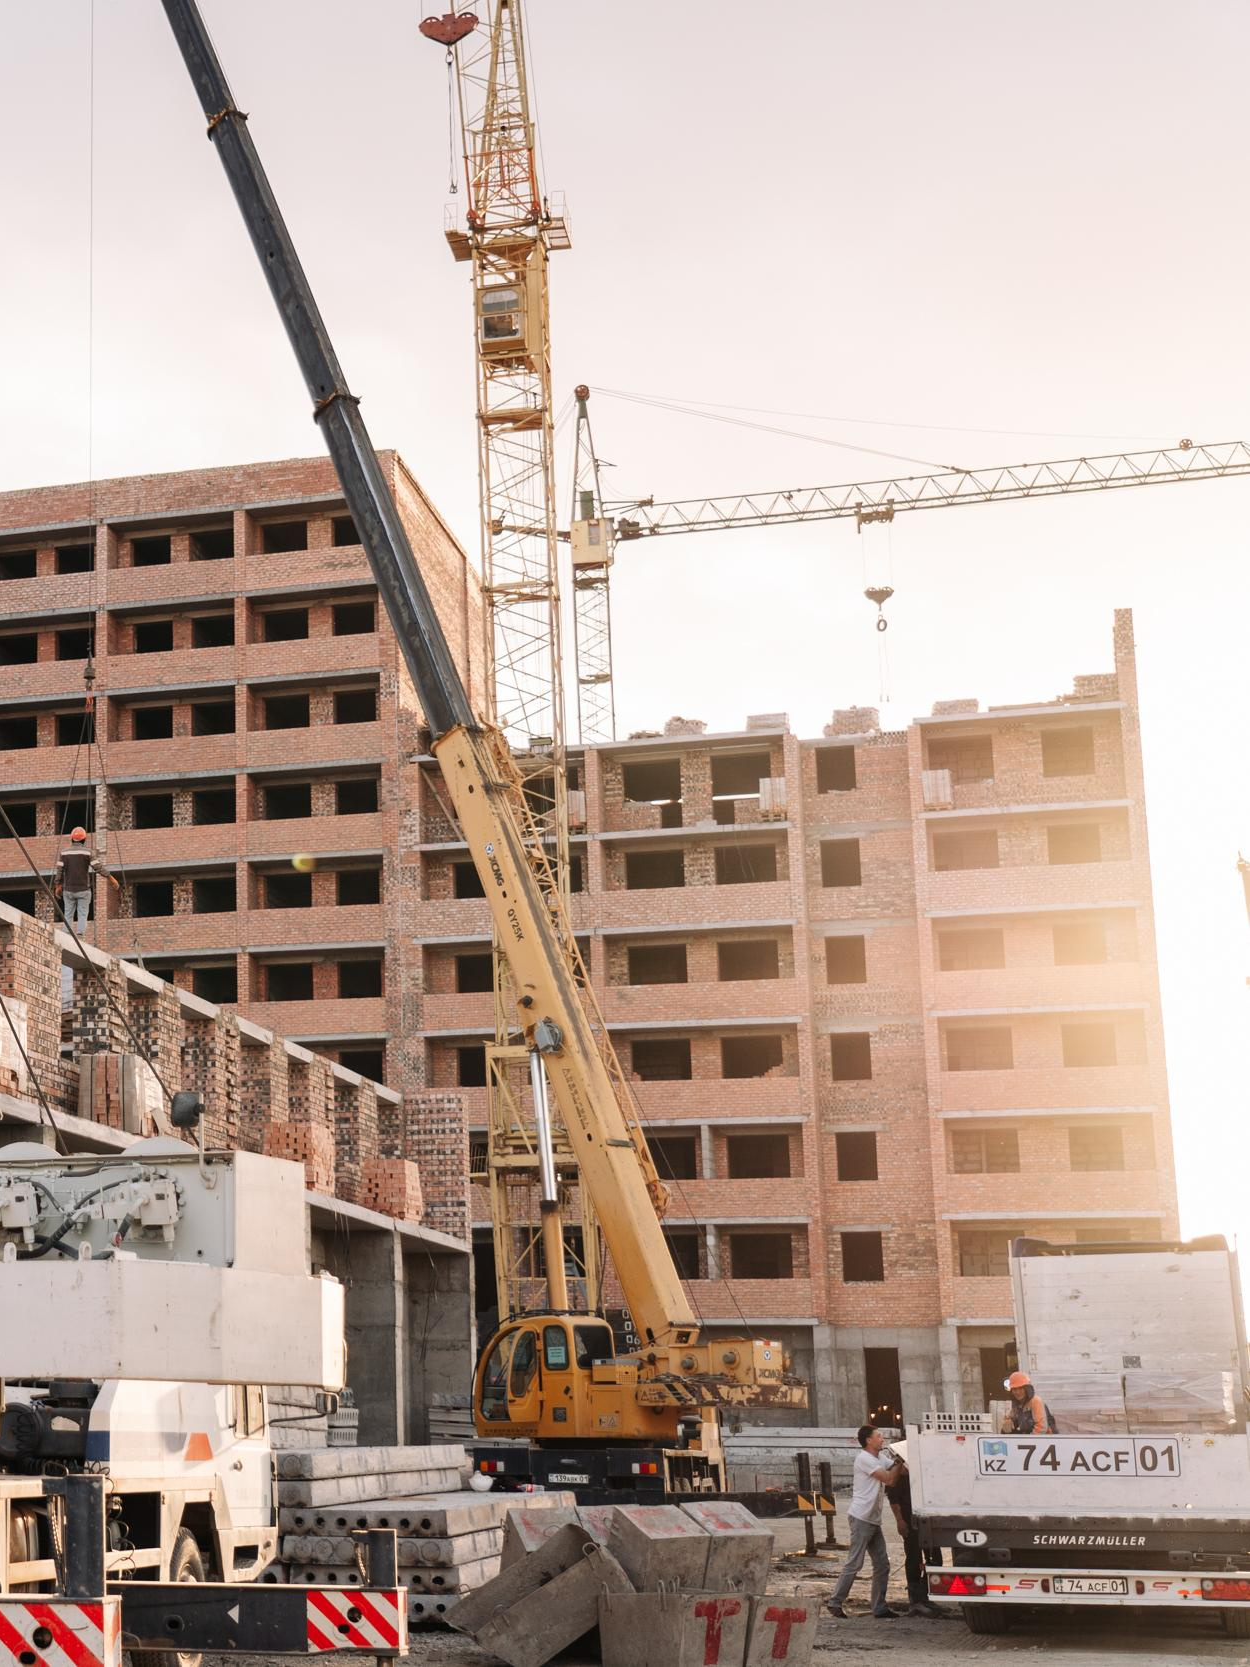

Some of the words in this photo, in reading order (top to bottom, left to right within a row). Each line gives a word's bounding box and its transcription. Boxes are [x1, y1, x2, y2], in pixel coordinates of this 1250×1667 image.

[507, 908, 525, 943] QY25K
[984, 1459, 1007, 1472] KZ
[1016, 1444, 1061, 1472] 74
[1069, 1450, 1130, 1472] ACF
[1139, 1445, 1176, 1472] 01
[963, 1531, 980, 1544] LT
[1067, 1580, 1083, 1592] 74
[1111, 1580, 1126, 1592] 01
[763, 1607, 807, 1660] T
